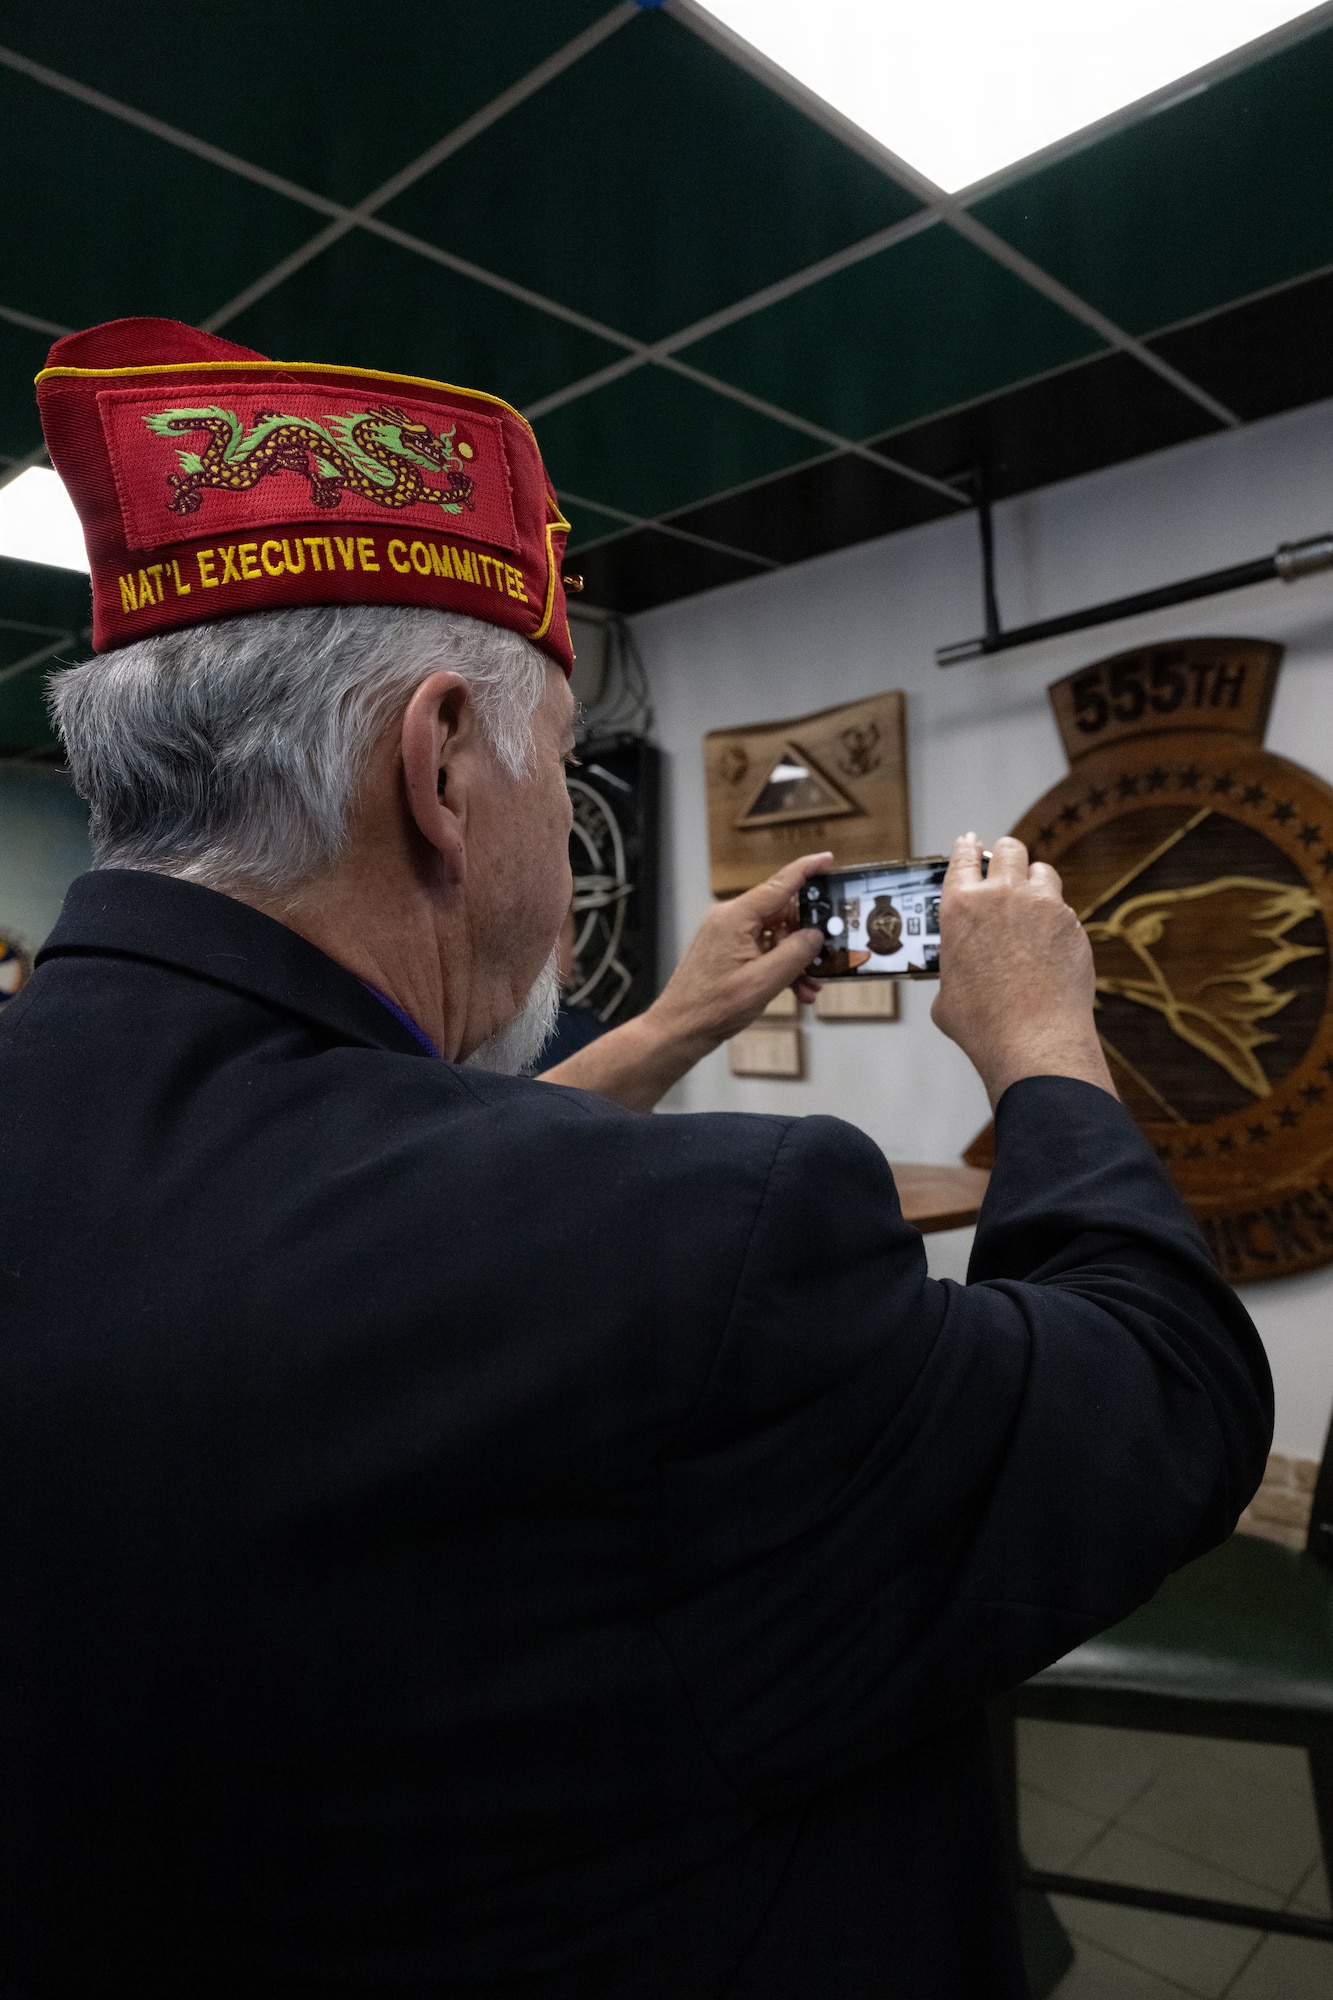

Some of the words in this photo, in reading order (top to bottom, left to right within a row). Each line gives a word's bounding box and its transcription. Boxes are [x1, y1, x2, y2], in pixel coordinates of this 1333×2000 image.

[118, 560, 191, 614] NAT'L
[197, 537, 380, 589] EXECUTIVE
[388, 538, 529, 603] COMMITTEE
[1071, 649, 1247, 733] 555TH
